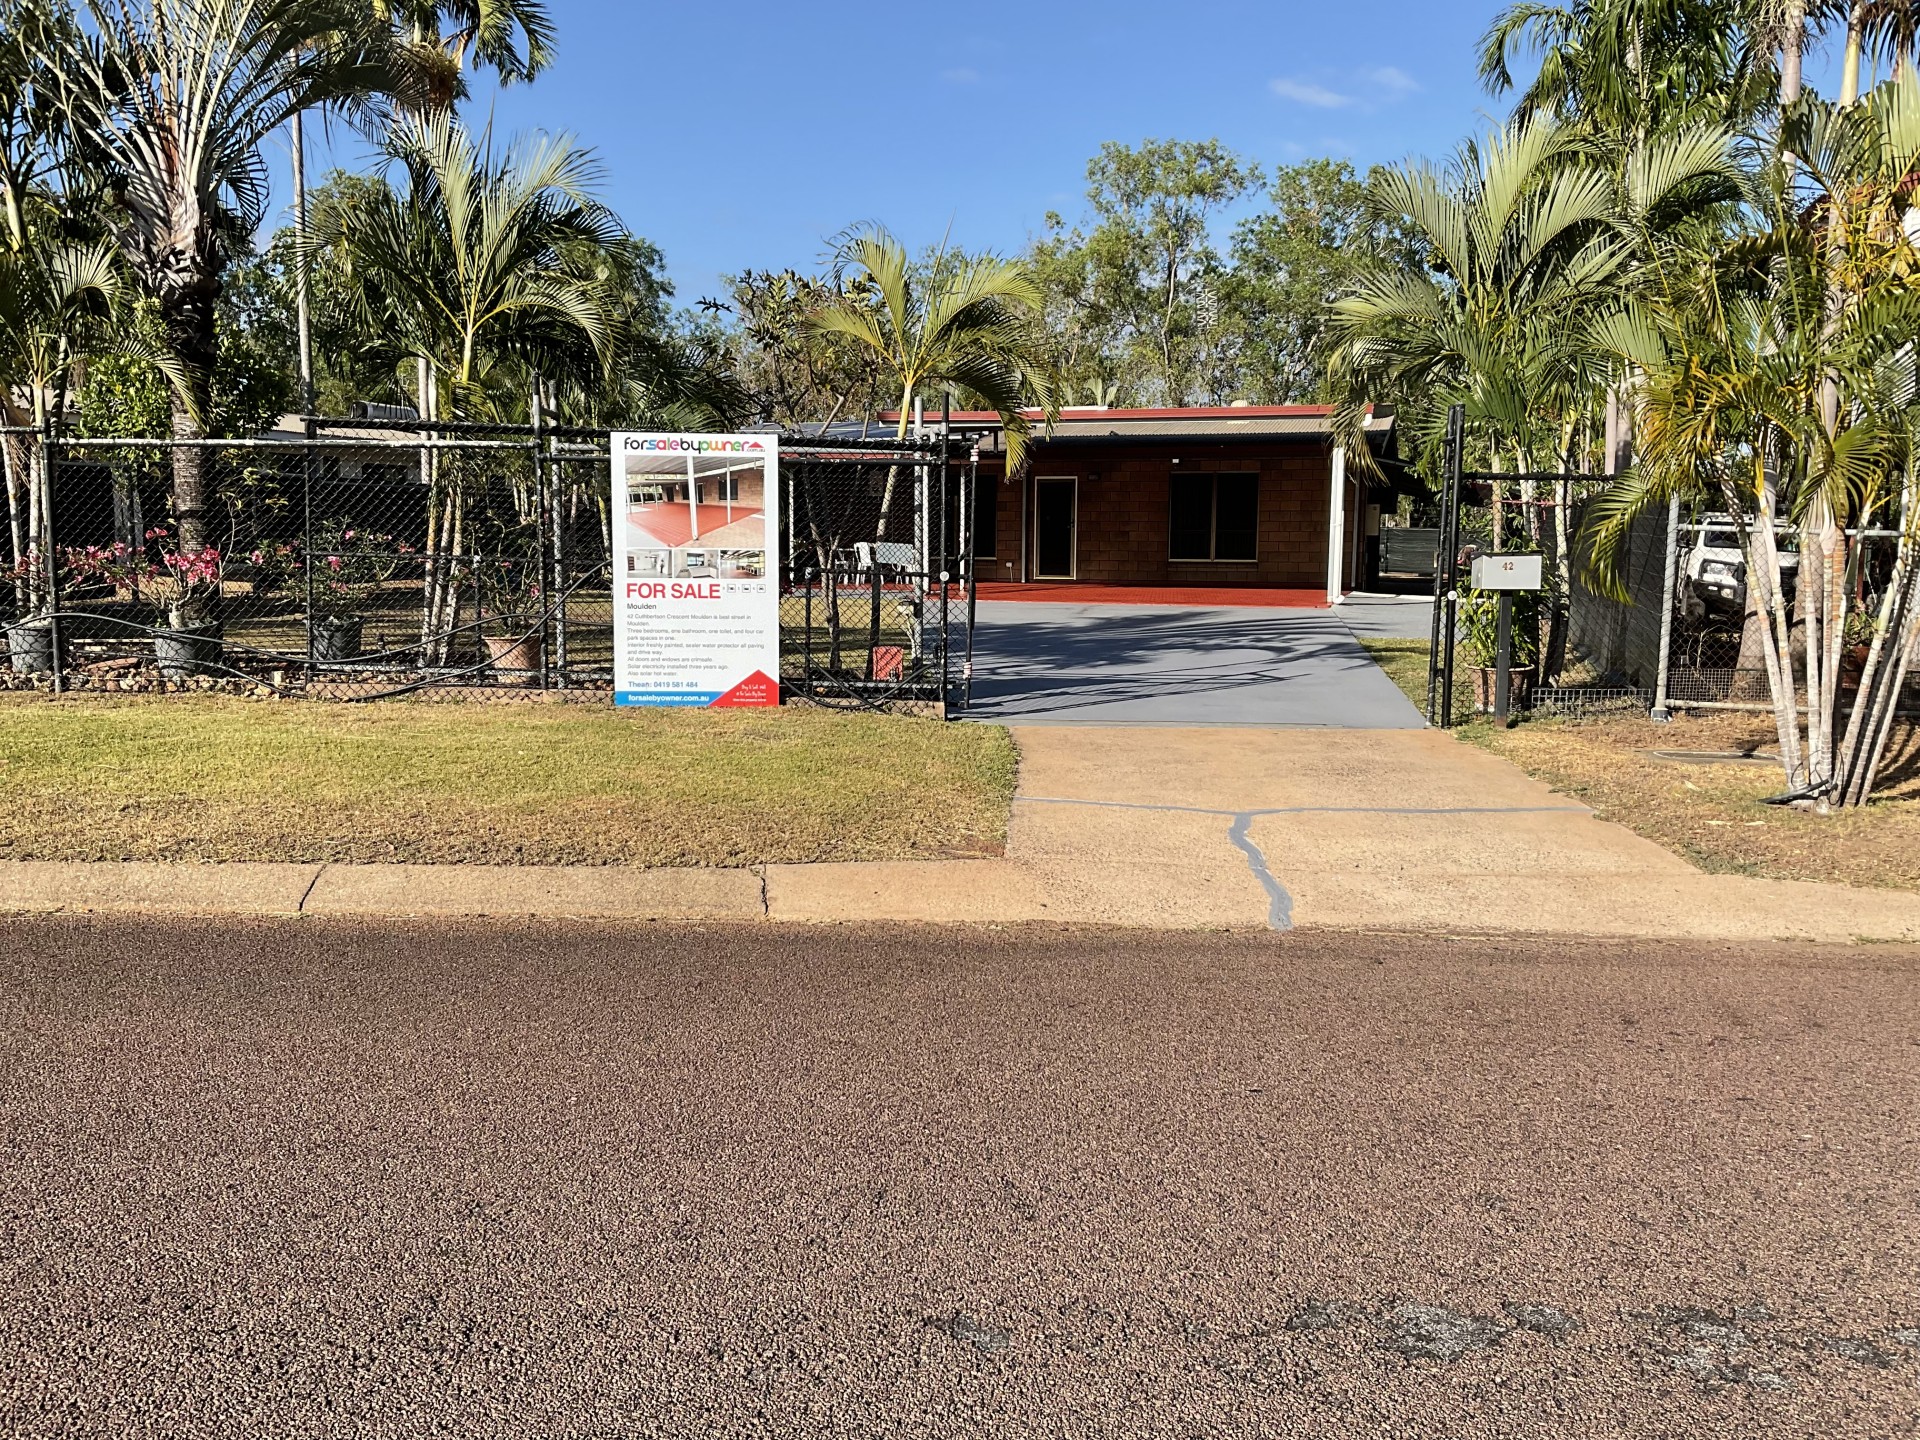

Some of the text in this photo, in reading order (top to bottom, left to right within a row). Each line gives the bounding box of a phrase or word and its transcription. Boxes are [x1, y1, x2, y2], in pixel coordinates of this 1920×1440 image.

[624, 436, 750, 454] forsalebyowner
[1502, 561, 1514, 570] 42
[626, 583, 721, 599] FOR SALE
[628, 694, 709, 702] forsalebyowner.com.au
